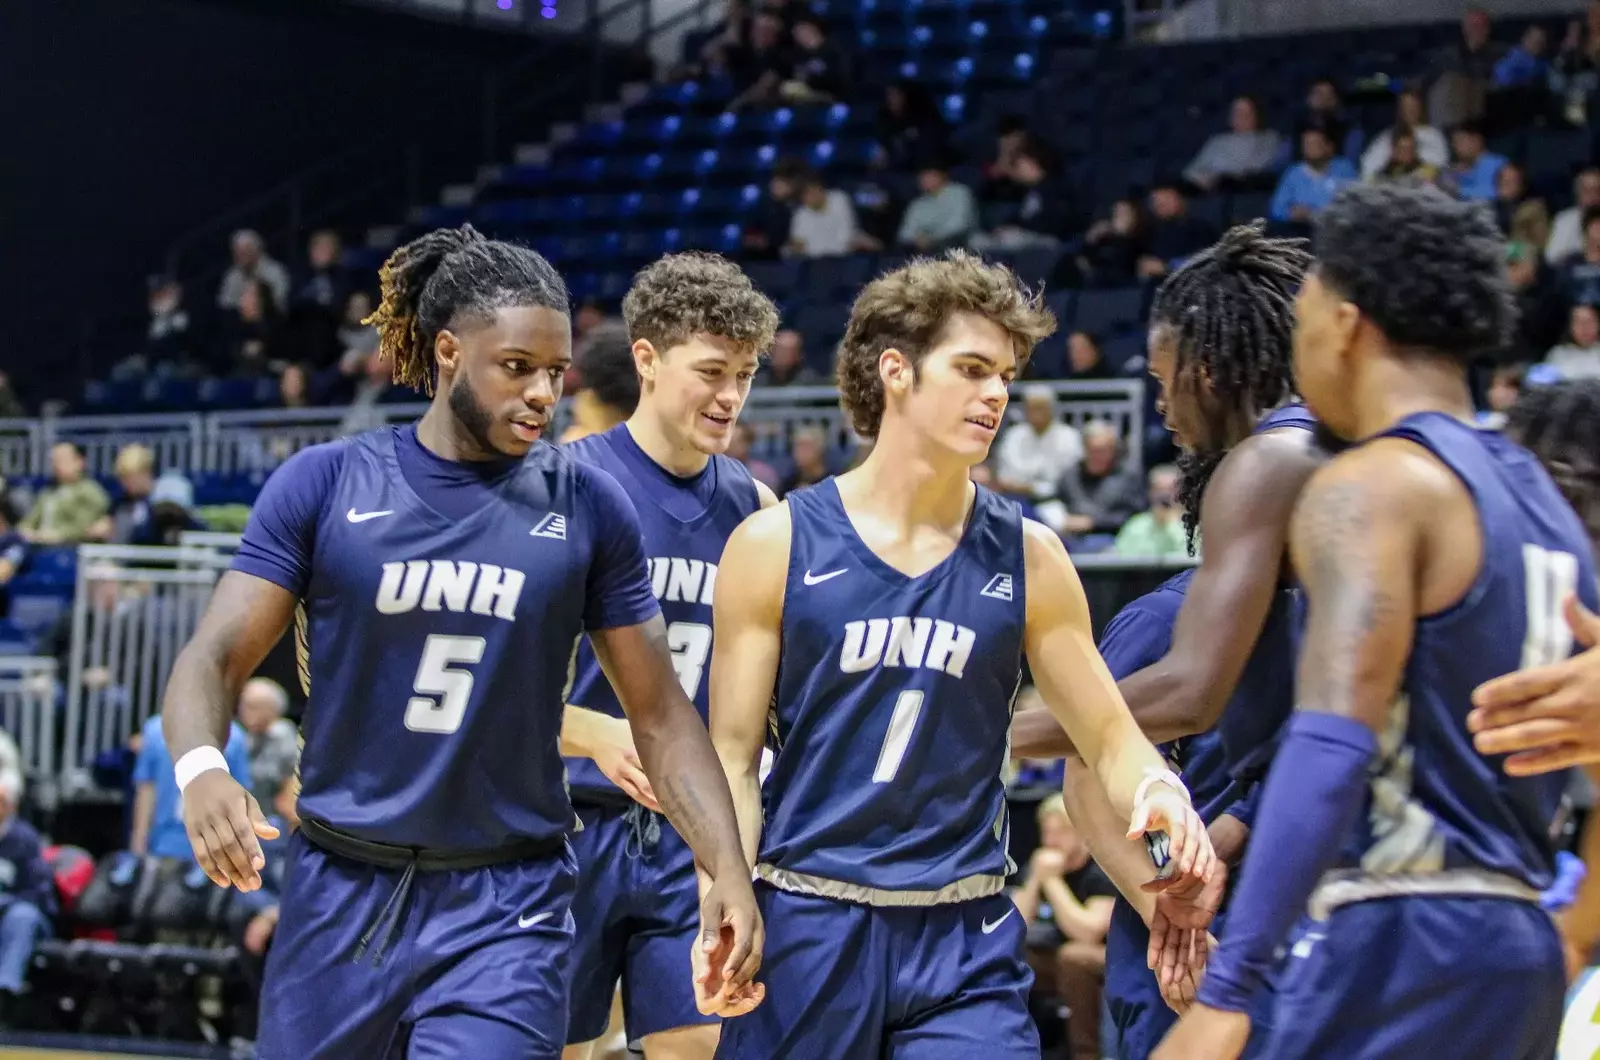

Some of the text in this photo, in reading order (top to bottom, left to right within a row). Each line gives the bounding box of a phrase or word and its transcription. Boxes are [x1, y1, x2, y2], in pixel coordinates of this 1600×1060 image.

[375, 559, 526, 622] UNH
[403, 633, 487, 735] 5
[839, 616, 976, 680] UNH
[872, 689, 925, 784] 1
